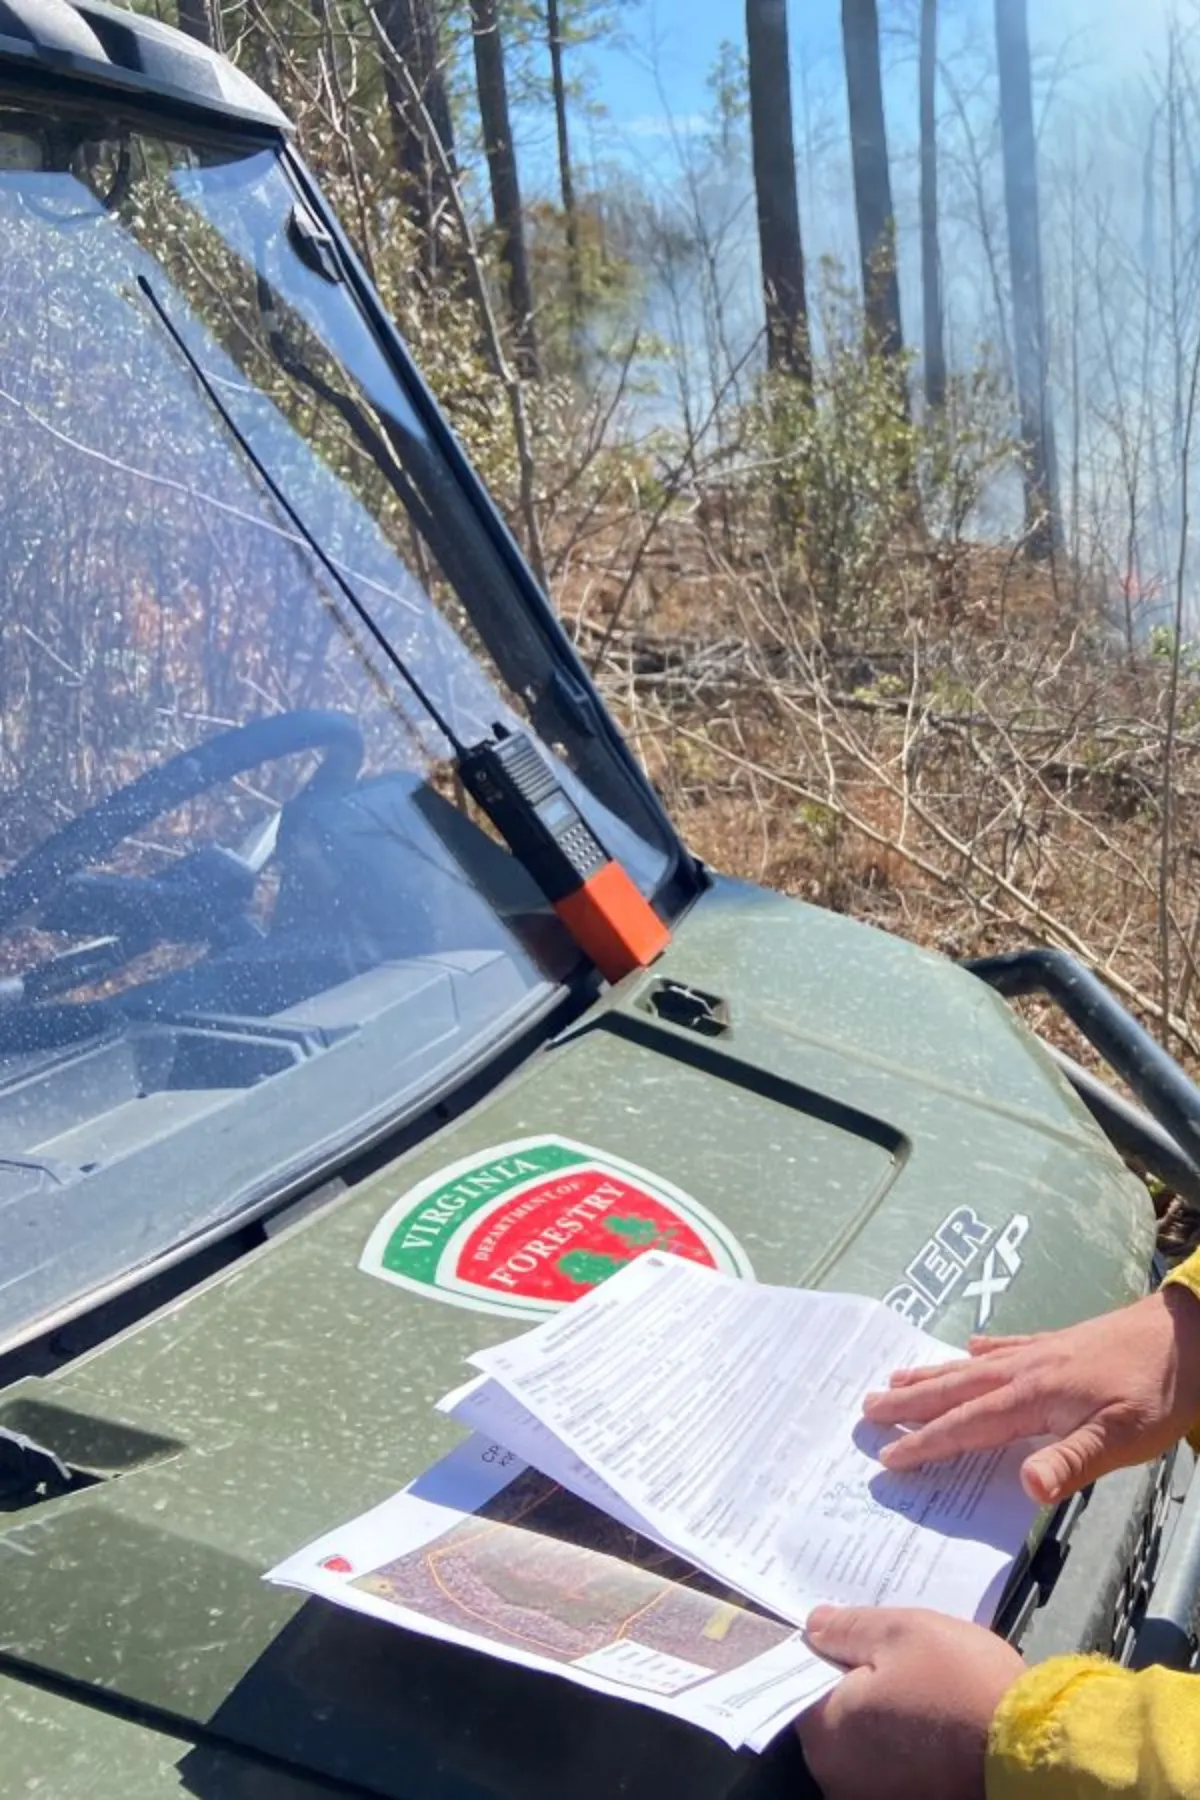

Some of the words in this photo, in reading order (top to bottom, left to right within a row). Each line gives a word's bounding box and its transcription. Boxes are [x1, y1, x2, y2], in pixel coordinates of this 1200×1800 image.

[400, 1157, 543, 1251] VIRGINIA
[472, 1190, 557, 1261] DEPARTMENT
[556, 1181, 581, 1196] OF
[488, 1181, 625, 1288] FORESTRY
[961, 1213, 1030, 1329] XP
